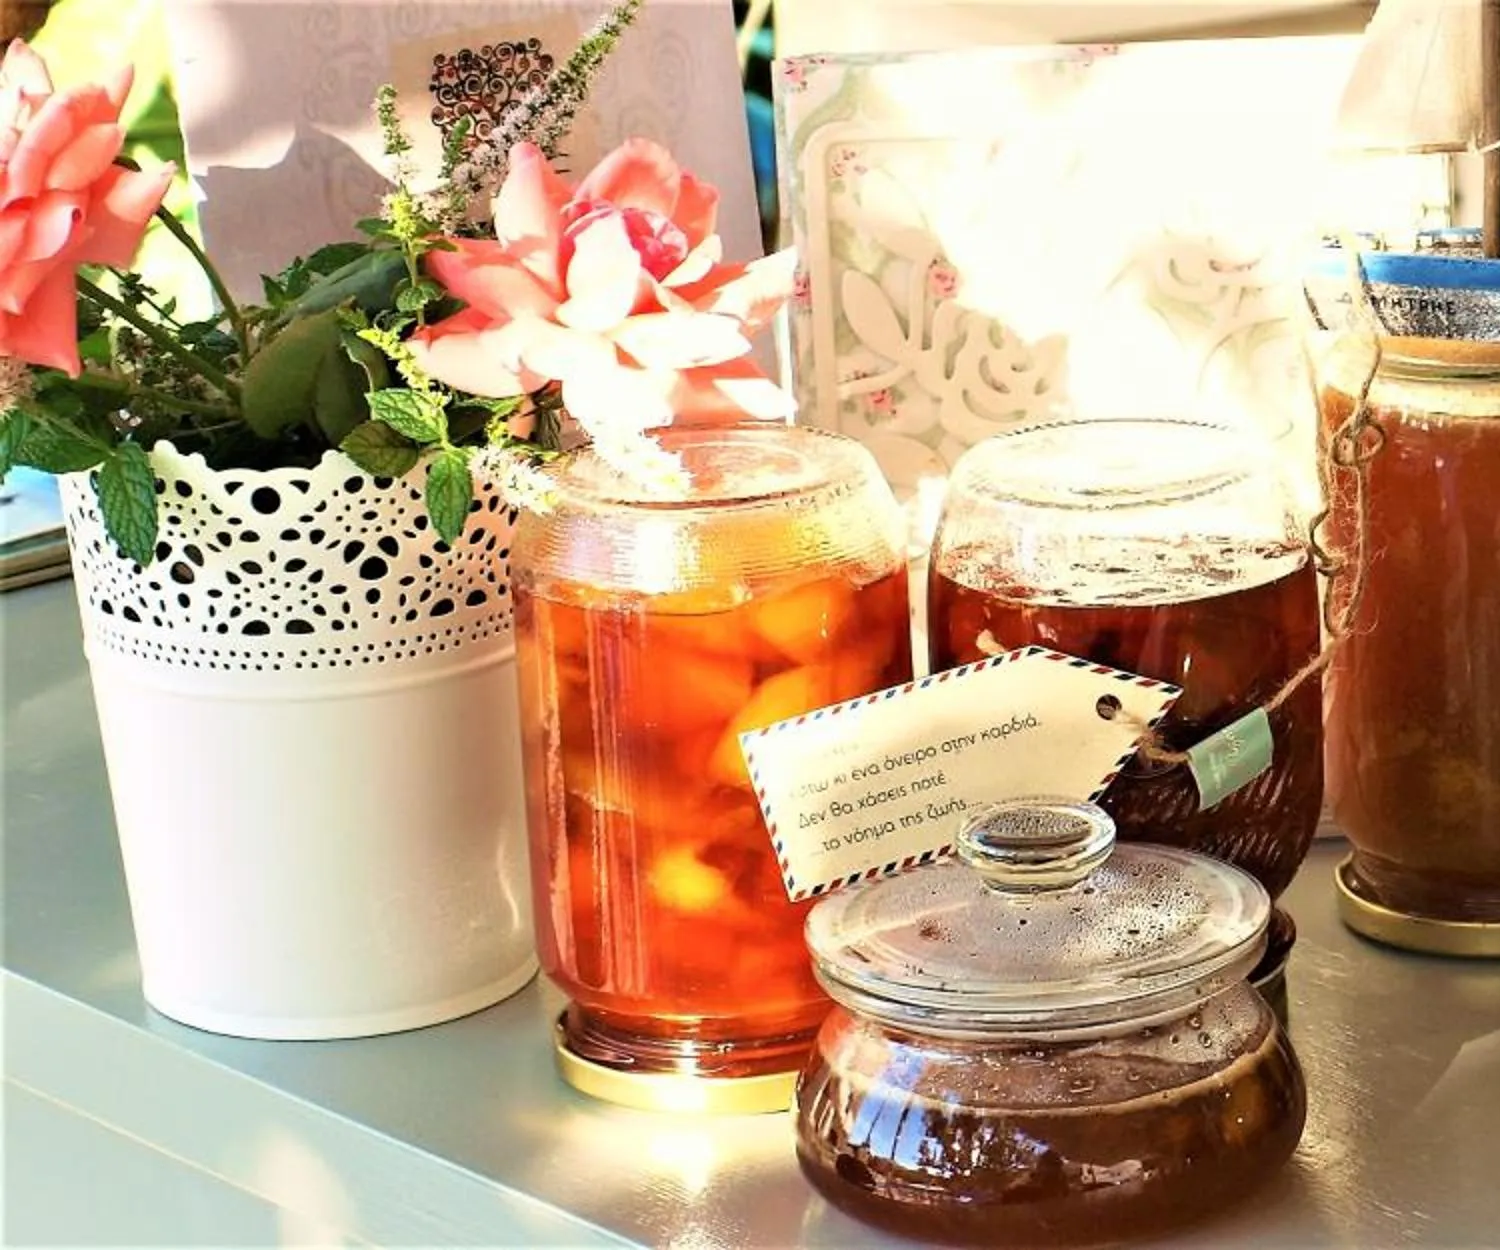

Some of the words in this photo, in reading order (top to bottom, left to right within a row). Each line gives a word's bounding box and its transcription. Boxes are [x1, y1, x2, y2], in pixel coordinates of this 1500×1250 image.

[882, 744, 937, 771] όνειρο
[939, 733, 977, 753] στην
[797, 808, 827, 829] Δεν
[828, 800, 854, 818] θα
[855, 784, 908, 810] χάσεις
[842, 820, 897, 845] νόημα
[897, 810, 924, 829] της
